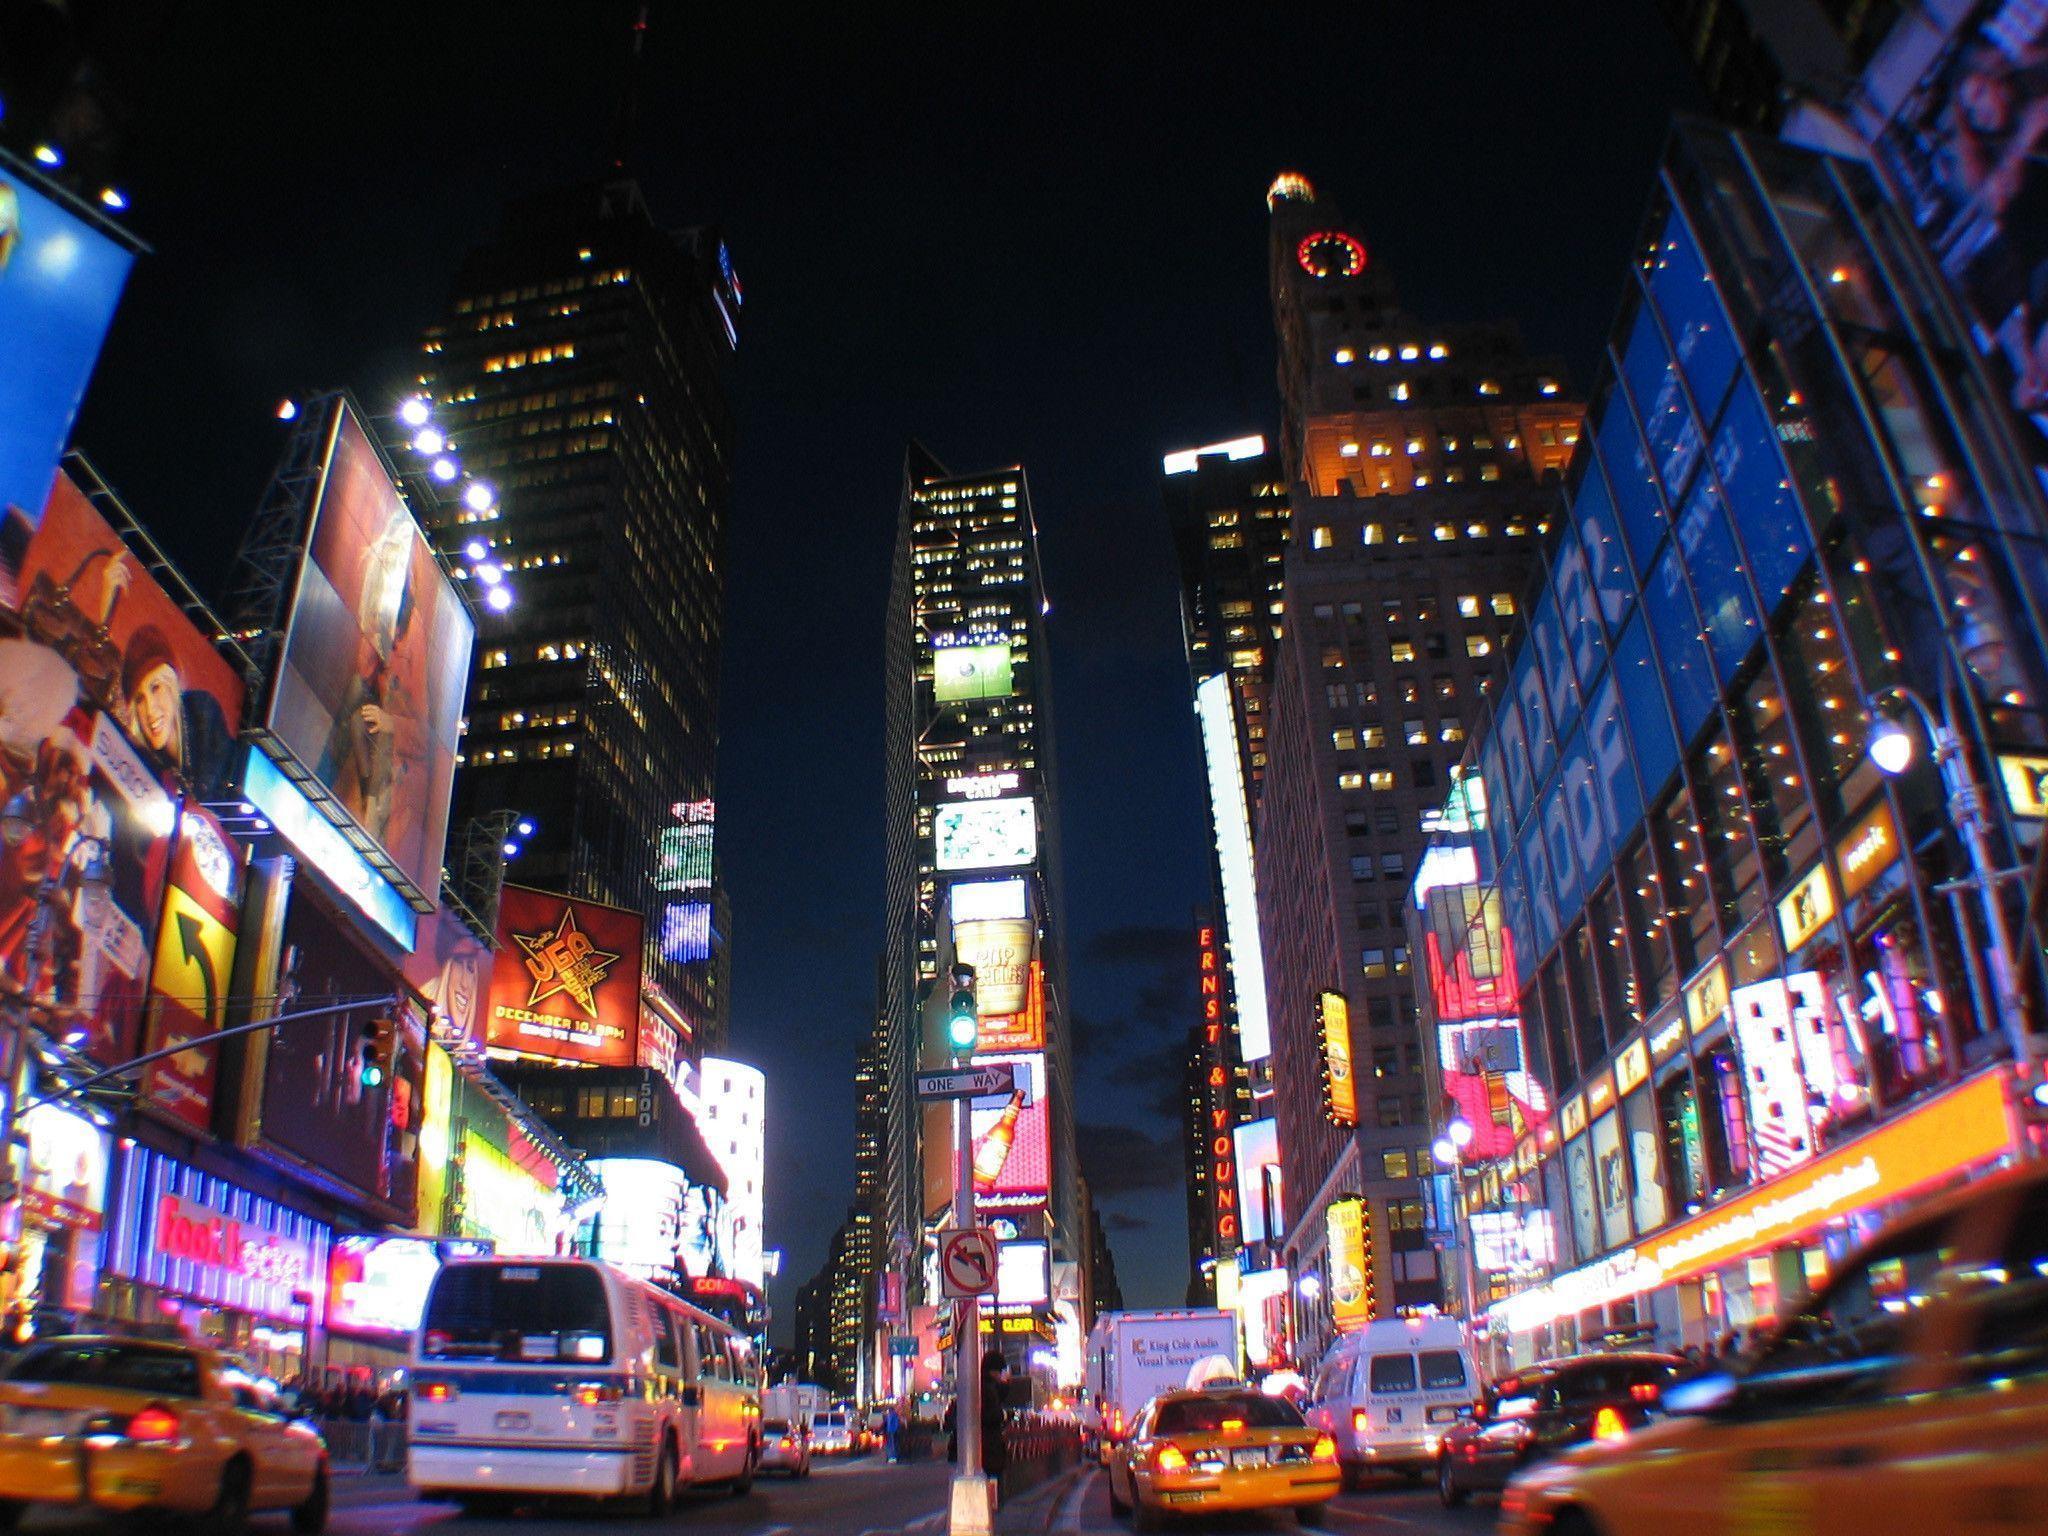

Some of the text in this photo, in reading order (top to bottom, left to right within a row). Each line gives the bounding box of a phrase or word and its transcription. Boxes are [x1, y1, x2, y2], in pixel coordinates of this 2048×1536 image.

[495, 1005, 572, 1030] DECEMBER
[639, 1068, 651, 1127] 1500
[927, 1073, 1001, 1092] ONE WAY
[1200, 928, 1236, 1236] ERNST & YOUNG
